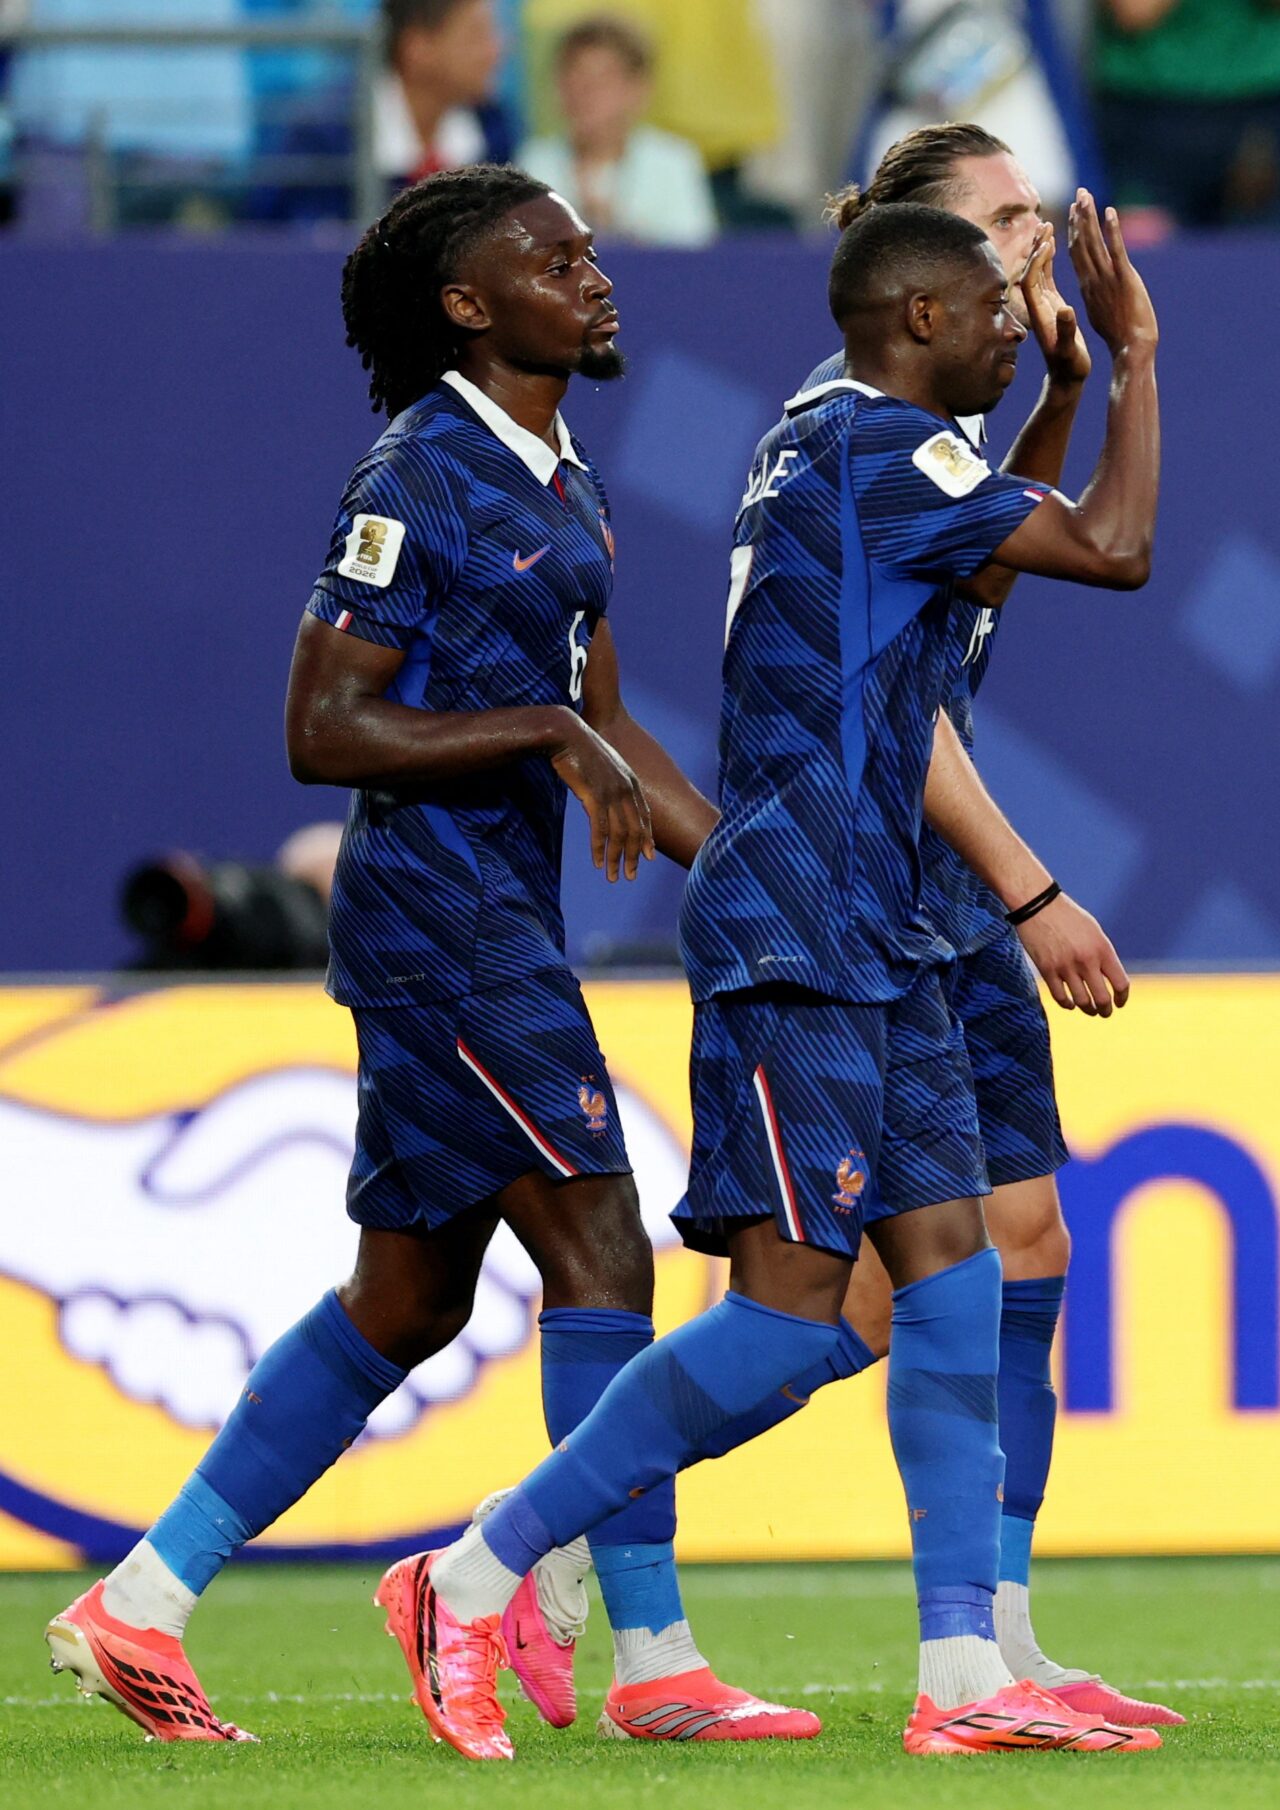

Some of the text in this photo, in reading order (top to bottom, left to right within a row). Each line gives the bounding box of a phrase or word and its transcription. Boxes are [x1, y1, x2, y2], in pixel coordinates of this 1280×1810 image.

[360, 553, 373, 562] FIFA
[349, 567, 376, 579] 2026
[568, 610, 588, 702] 6
